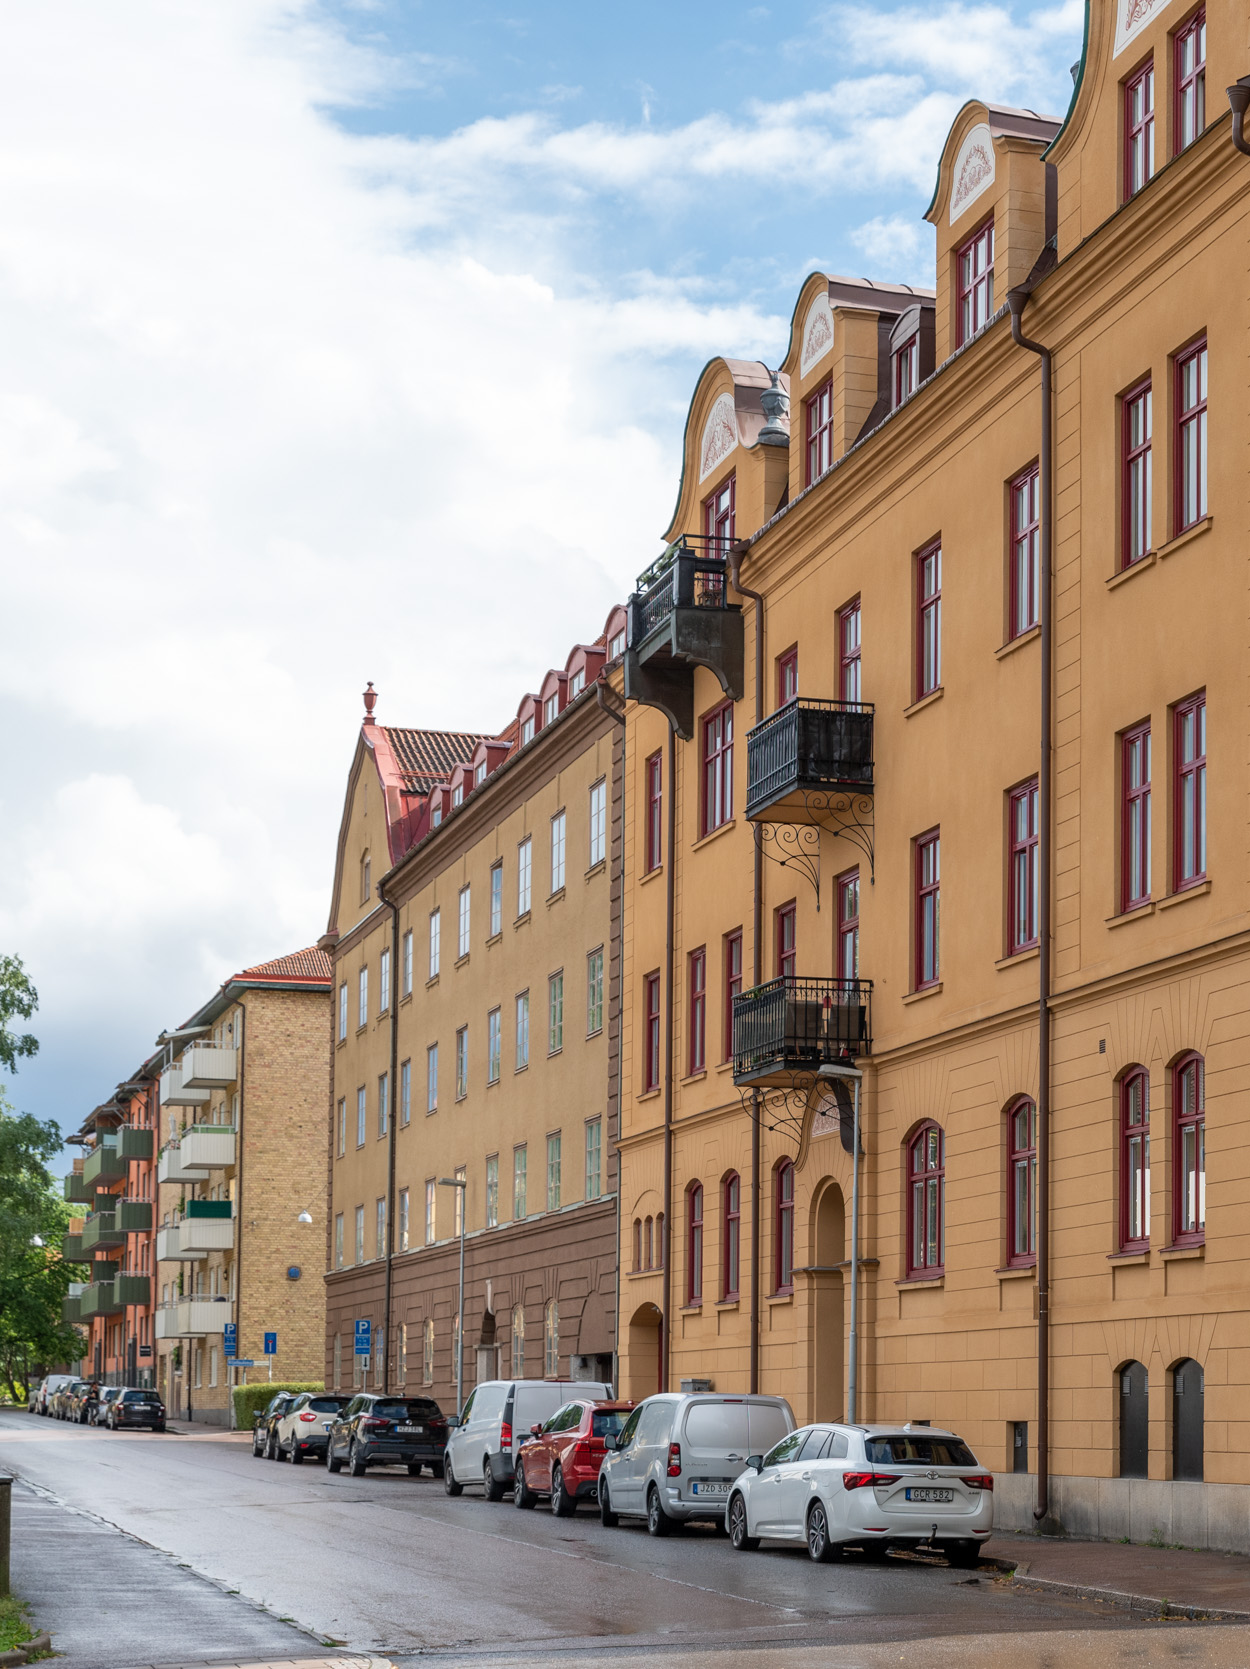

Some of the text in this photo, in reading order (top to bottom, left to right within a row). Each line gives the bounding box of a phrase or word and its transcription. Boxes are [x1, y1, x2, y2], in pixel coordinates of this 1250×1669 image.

[227, 1324, 235, 1334] P
[359, 1321, 368, 1334] P
[914, 1490, 950, 1499] GCR 582
